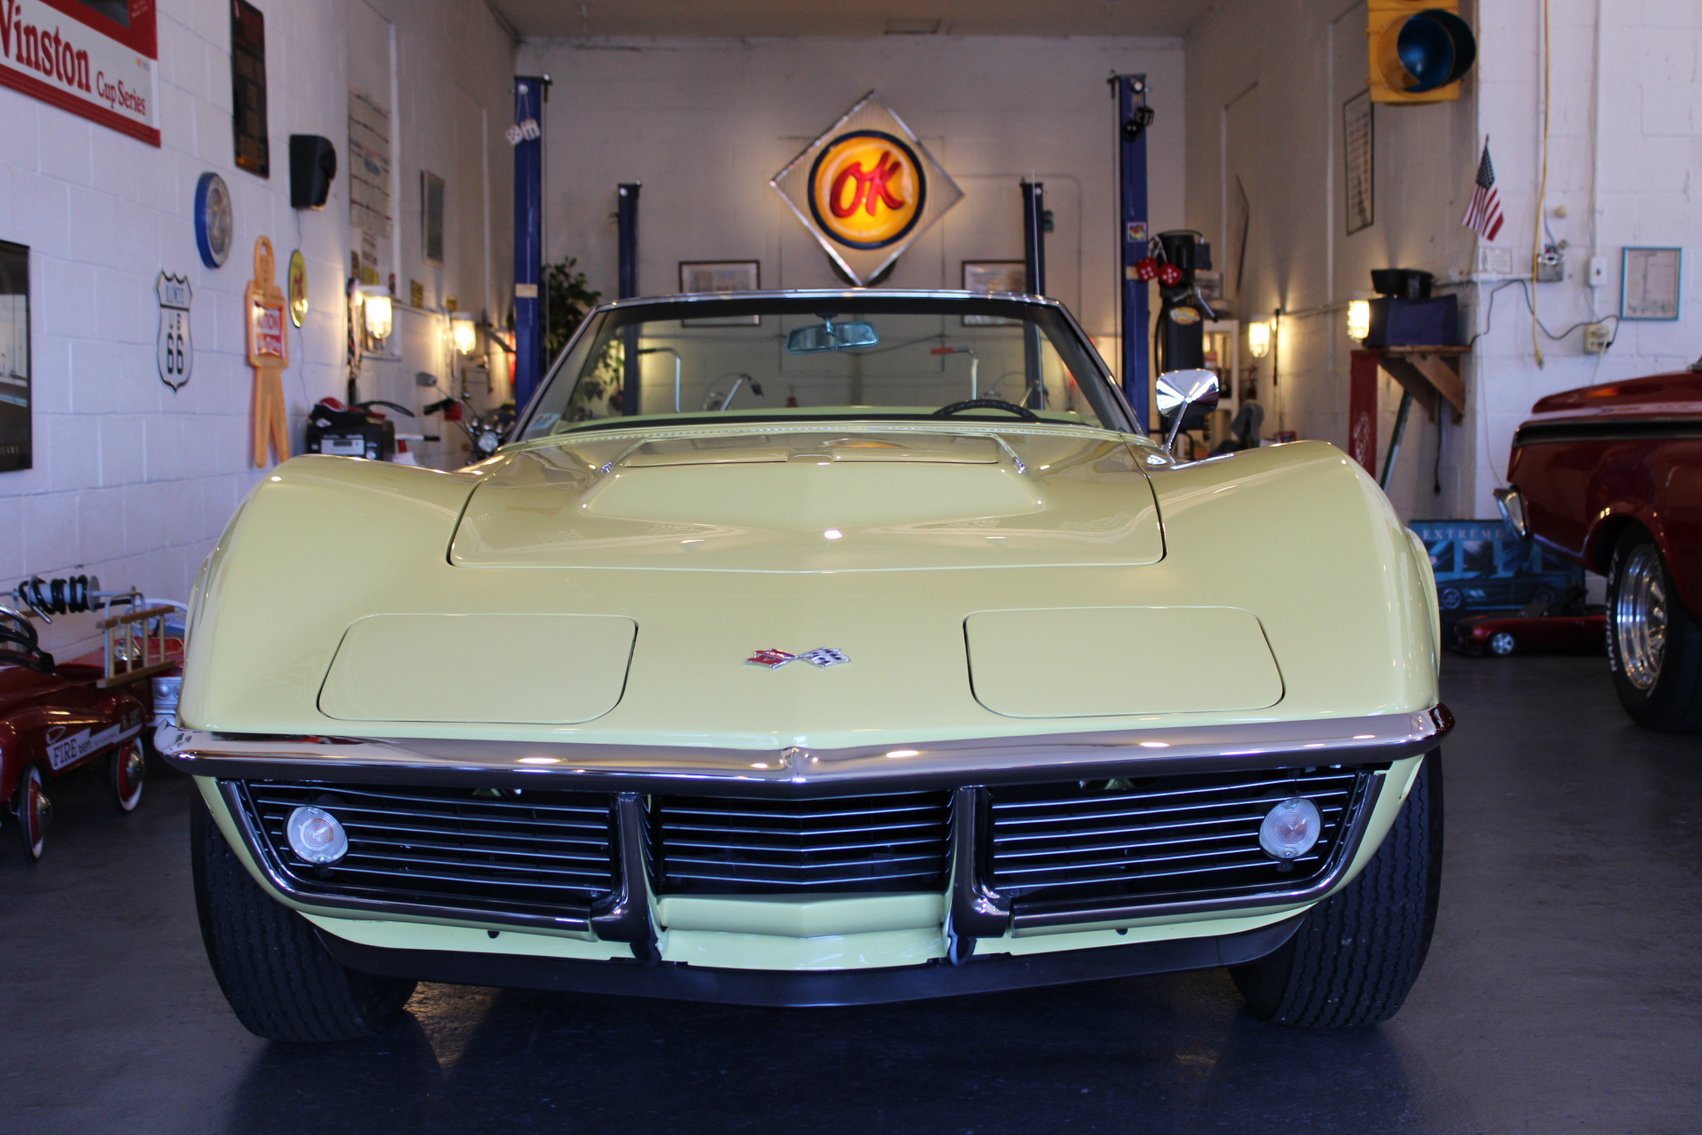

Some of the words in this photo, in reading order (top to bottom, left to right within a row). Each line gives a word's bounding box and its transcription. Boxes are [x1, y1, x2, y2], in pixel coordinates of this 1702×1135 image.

[96, 70, 116, 110] Cup
[117, 79, 147, 116] Series
[829, 149, 905, 218] OK
[167, 332, 184, 375] 66
[1422, 529, 1504, 541] EXTREME
[53, 737, 78, 767] FIRE
